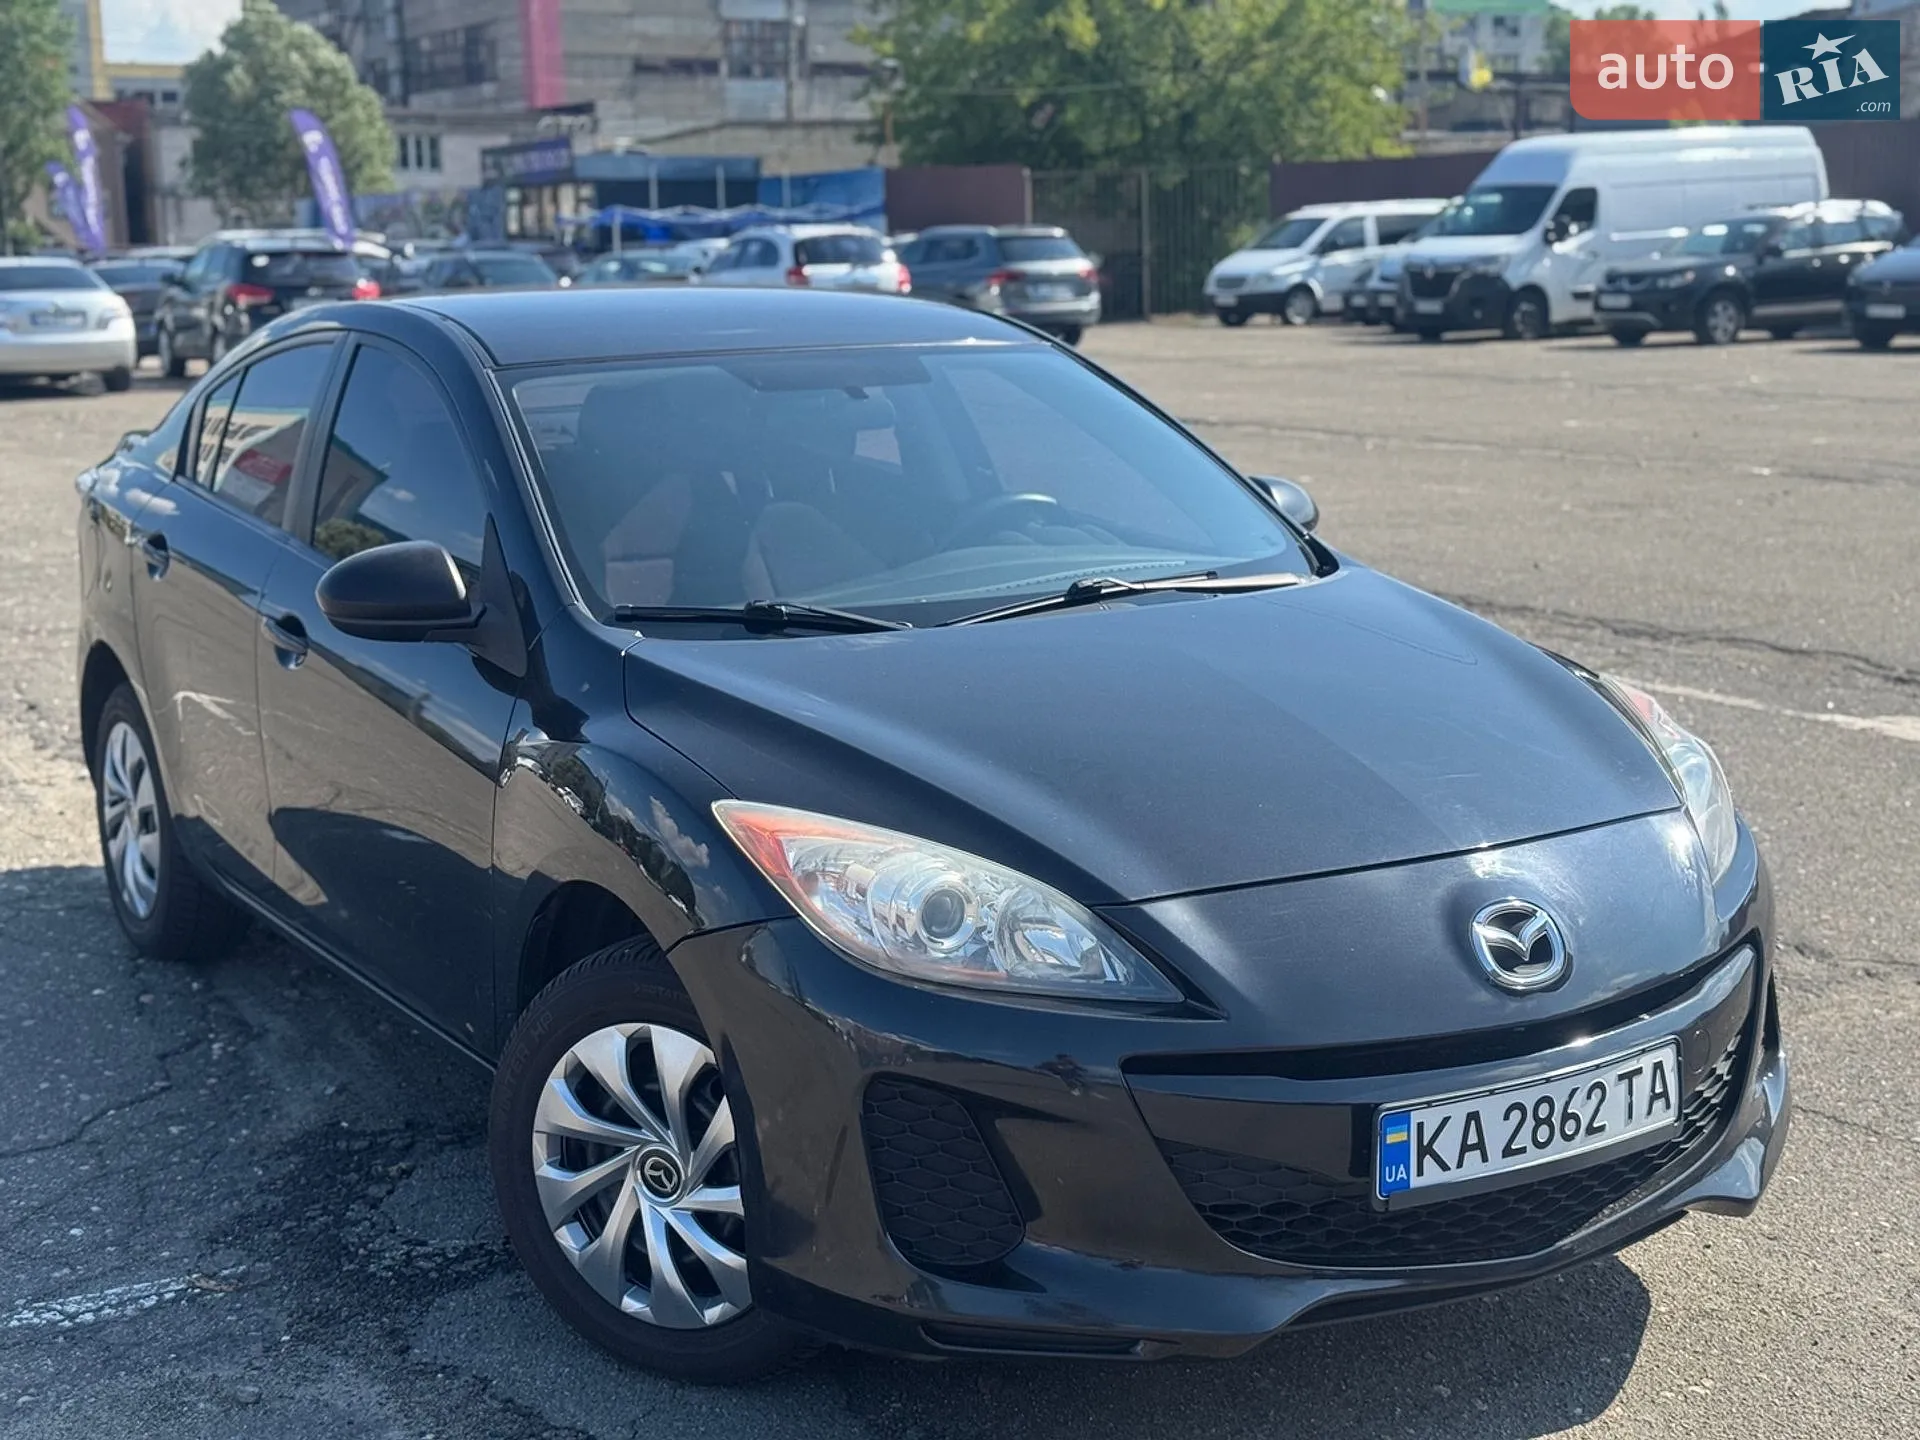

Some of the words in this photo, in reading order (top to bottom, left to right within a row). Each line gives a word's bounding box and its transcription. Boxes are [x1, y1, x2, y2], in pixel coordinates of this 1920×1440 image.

[1416, 1110, 1489, 1177] KA
[1502, 1080, 1607, 1158] 2862
[1617, 1060, 1671, 1122] TA
[1385, 1163, 1408, 1182] UA
